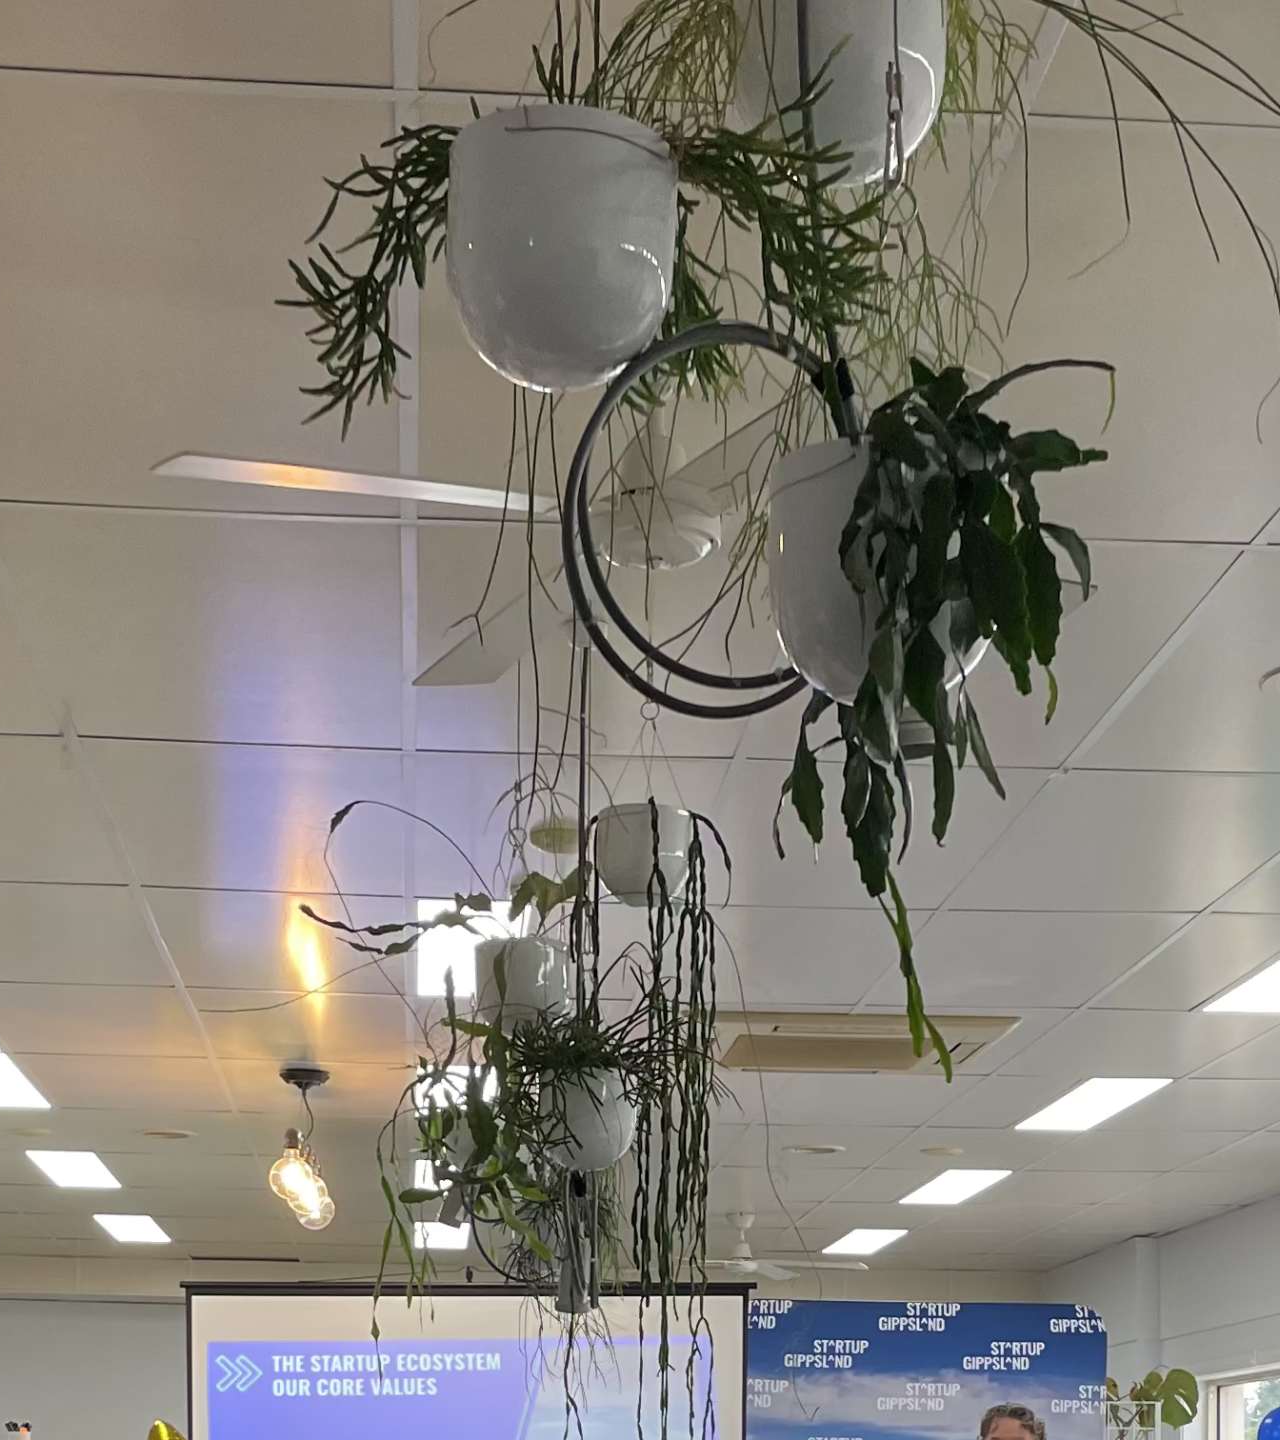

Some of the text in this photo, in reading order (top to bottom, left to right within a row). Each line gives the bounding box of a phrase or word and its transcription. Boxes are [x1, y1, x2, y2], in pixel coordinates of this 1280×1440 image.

[271, 1352, 502, 1373] THE STARTUP ECOSYSTEM
[272, 1377, 438, 1397] OUR CORE VALUES
